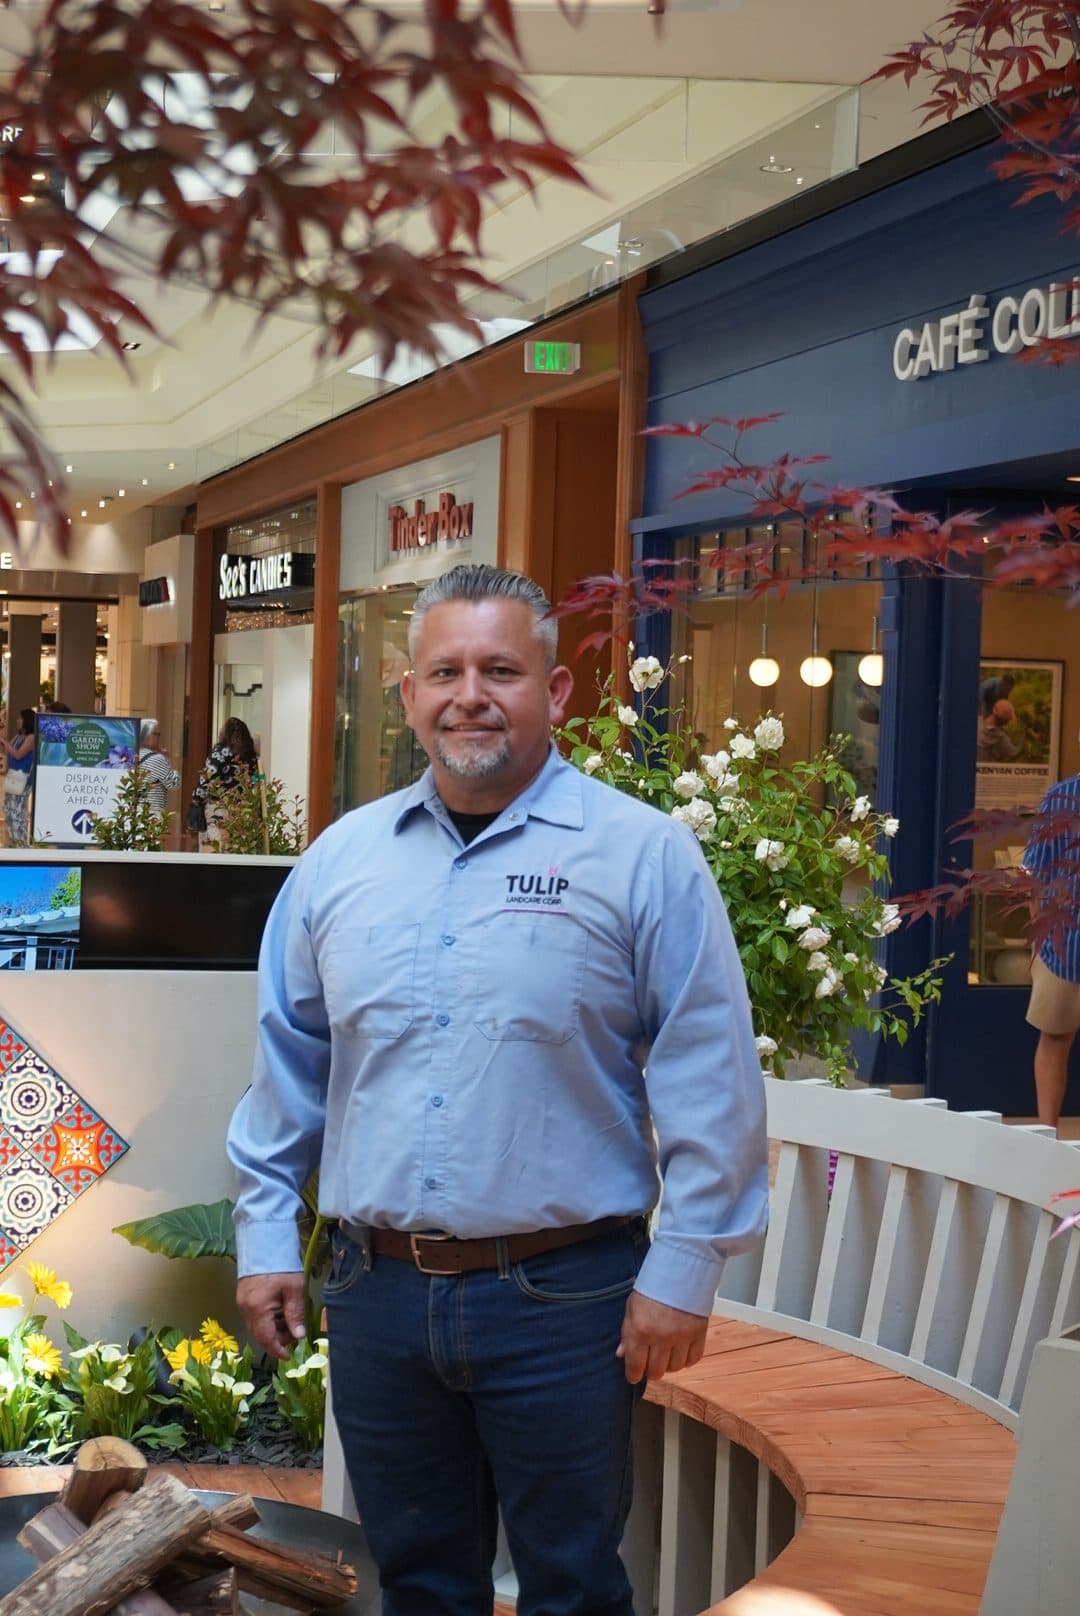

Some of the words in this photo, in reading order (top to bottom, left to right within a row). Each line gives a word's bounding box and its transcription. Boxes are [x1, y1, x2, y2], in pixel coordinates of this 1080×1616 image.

[893, 294, 990, 381] CAFÉ
[534, 341, 568, 370] EXIT
[388, 499, 438, 551] Tinder
[438, 492, 474, 541] Box
[219, 553, 247, 600] See's
[249, 551, 292, 594] CANDIES
[71, 736, 105, 745] GARDEN
[65, 773, 107, 784] DISPLAY
[975, 766, 1012, 775] KENYAN
[1014, 767, 1049, 776] COFFEE
[62, 784, 109, 794] GARDEN
[66, 795, 104, 805] AHEAD
[506, 875, 569, 895] TULIP
